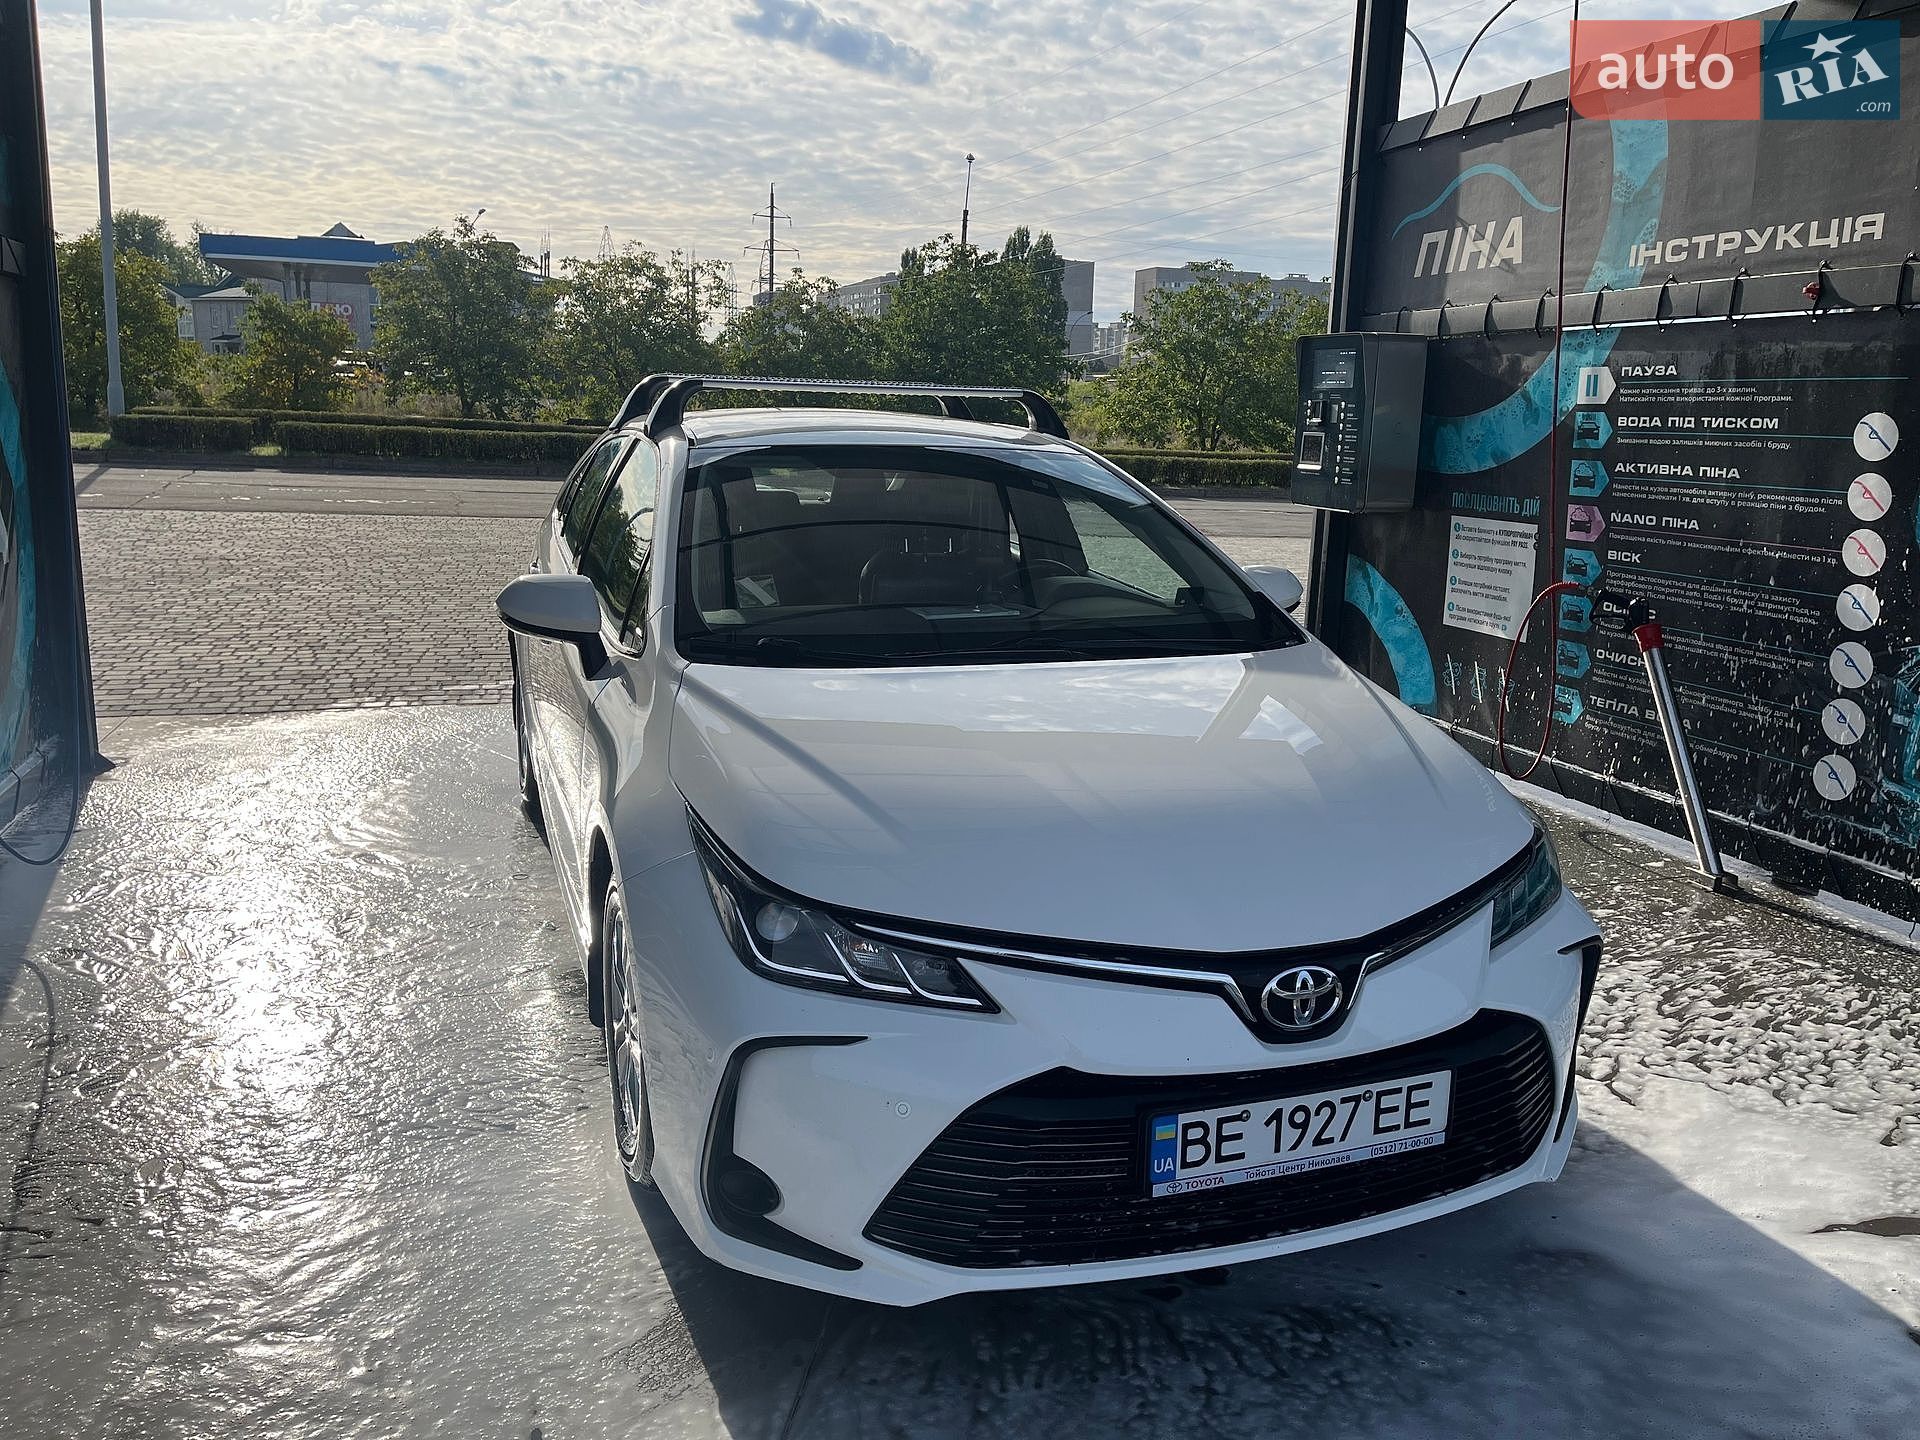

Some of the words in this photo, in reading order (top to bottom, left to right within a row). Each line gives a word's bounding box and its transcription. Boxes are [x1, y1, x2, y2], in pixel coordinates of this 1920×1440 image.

[1414, 215, 1523, 278] ПІНА
[1628, 212, 1885, 268] ІНСТРУКЦІЯ
[1621, 365, 1678, 377] ПАУЗА
[1617, 416, 1662, 427] ВОДА
[1667, 417, 1695, 428] ПІД
[1701, 417, 1779, 429] ТИСКОМ
[1734, 440, 1762, 448] засобів
[1767, 441, 1792, 450] бруду.
[1614, 463, 1693, 476] АКТИВНА
[1699, 466, 1740, 479] ПІНА
[1613, 483, 1639, 491] Нанести
[1757, 493, 1820, 504] рекомендовано
[1821, 497, 1843, 505] після
[1521, 496, 1540, 517] ДІЙ
[1737, 500, 1768, 509] реакцію
[1794, 503, 1827, 513] брудом.
[1610, 513, 1656, 526] NANO
[1662, 517, 1699, 530] ПІНА
[1609, 533, 1645, 541] Покращена
[1607, 550, 1641, 563] ВІСК
[1589, 695, 1639, 717] ТЕПЛА
[1180, 1114, 1246, 1169] BE
[1264, 1094, 1363, 1153] 1927
[1373, 1081, 1433, 1135] EE
[1154, 1157, 1175, 1173] UA
[1245, 1167, 1276, 1180] Тойота
[1278, 1161, 1306, 1175] Центр
[1308, 1155, 1350, 1169] Николаев
[1370, 1143, 1397, 1158] (0512)
[1398, 1136, 1434, 1150] 71-00-00
[1185, 1176, 1225, 1190] TOYOTA
